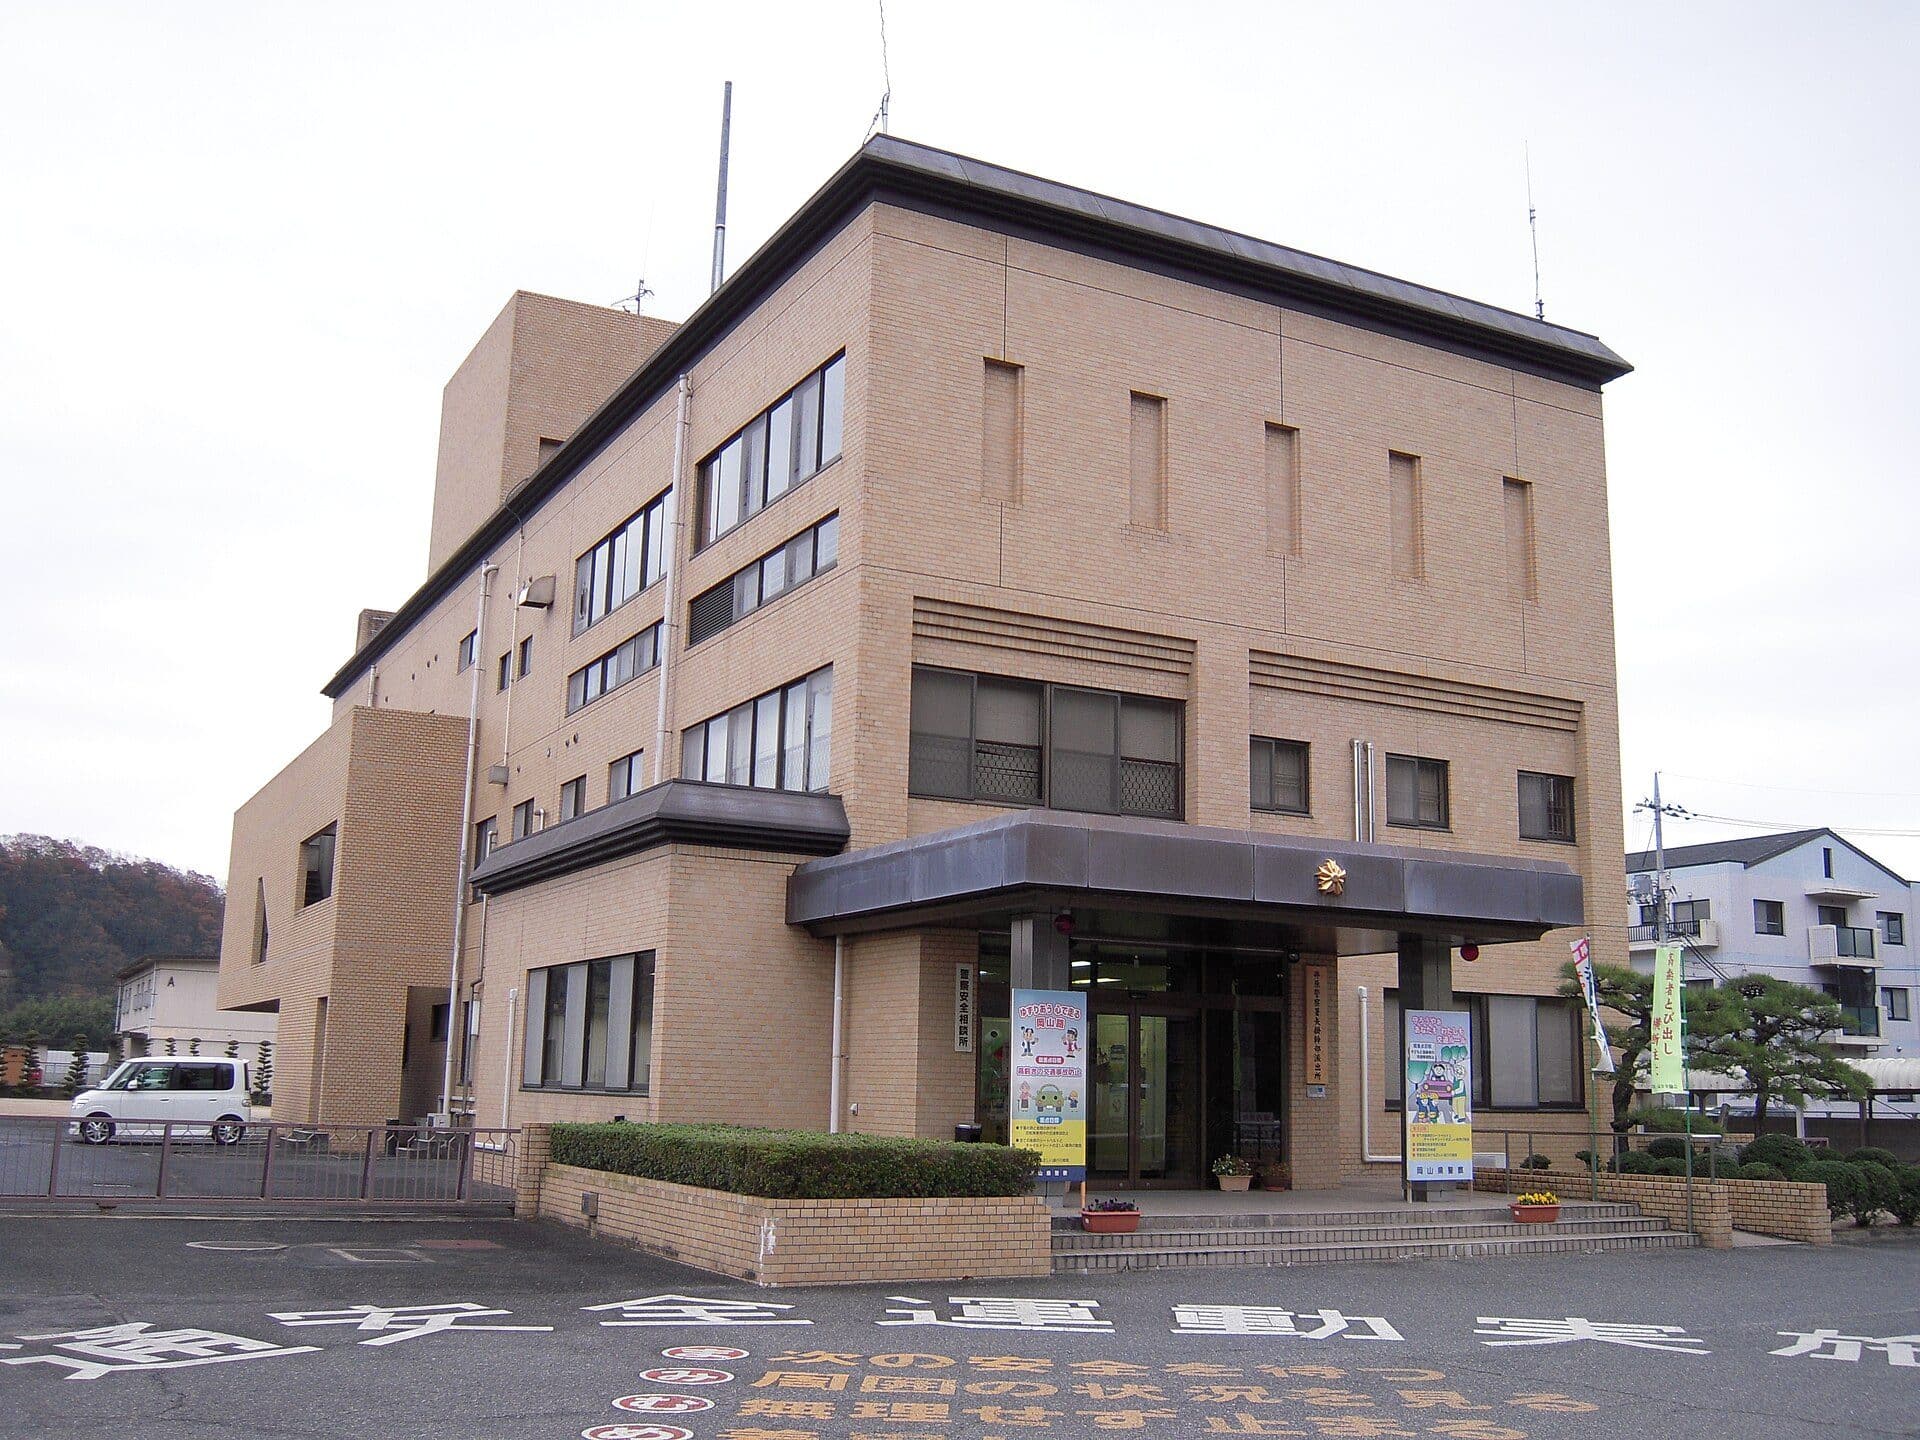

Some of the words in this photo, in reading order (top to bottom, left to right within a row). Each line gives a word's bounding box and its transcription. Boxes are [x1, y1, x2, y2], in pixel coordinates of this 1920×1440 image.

[750, 1371, 1600, 1412] 周囲の状況を見る
[736, 1398, 1530, 1440] 無理せず止まる
